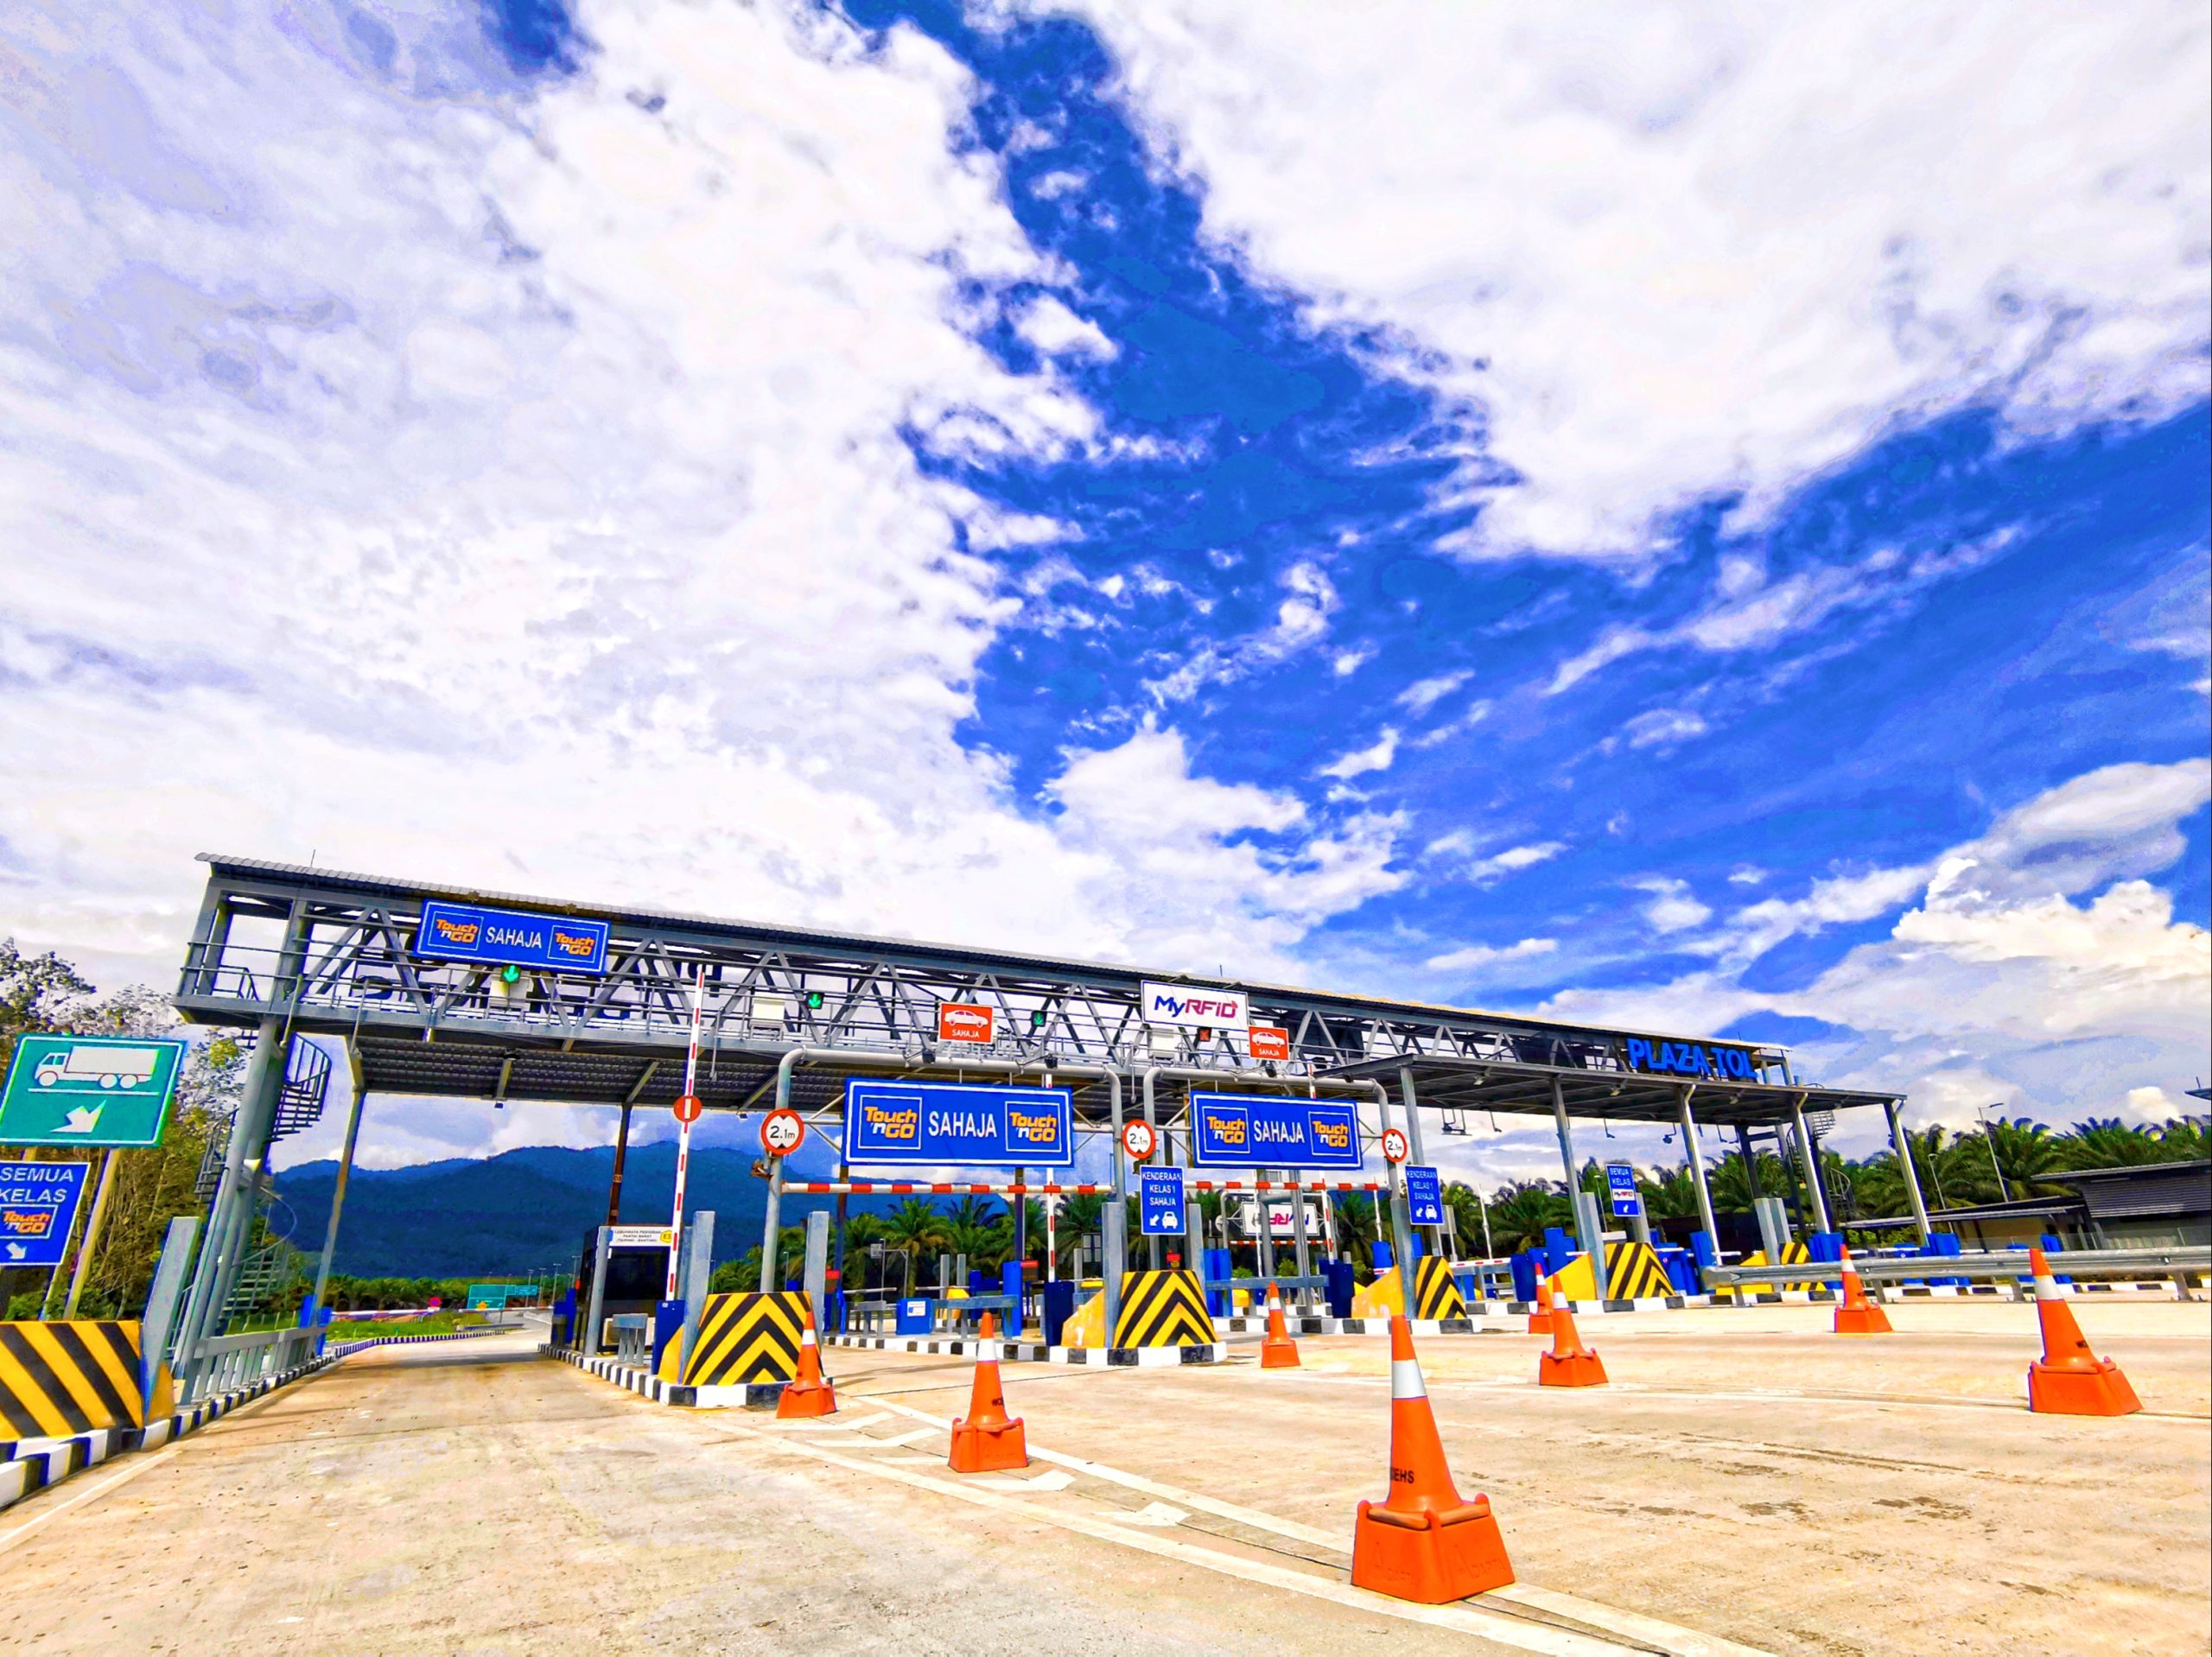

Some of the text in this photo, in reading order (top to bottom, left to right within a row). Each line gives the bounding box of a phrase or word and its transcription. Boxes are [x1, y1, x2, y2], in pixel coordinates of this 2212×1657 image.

[436, 918, 479, 934] Touch
[485, 926, 543, 949] SAHAJA
[555, 932, 595, 947] Touch
[952, 1029, 980, 1038] SAHAJA
[1259, 1048, 1280, 1057] SAHAJA
[1626, 1038, 1758, 1078] PLAZA TOL
[864, 1106, 918, 1124] Touch
[1009, 1112, 1057, 1128] Touch
[928, 1110, 997, 1138] SAHAJA
[1207, 1116, 1245, 1131] Touch
[1313, 1121, 1349, 1134] Touch
[1254, 1120, 1306, 1144] SAHAJA
[0, 1167, 74, 1183] SEMUA
[1142, 1171, 1181, 1182] KENDERAAN
[0, 1189, 67, 1203] KELAS
[1149, 1184, 1172, 1193] KELAS
[1149, 1197, 1176, 1206] SAHAJA
[3, 1210, 52, 1222] Touch
